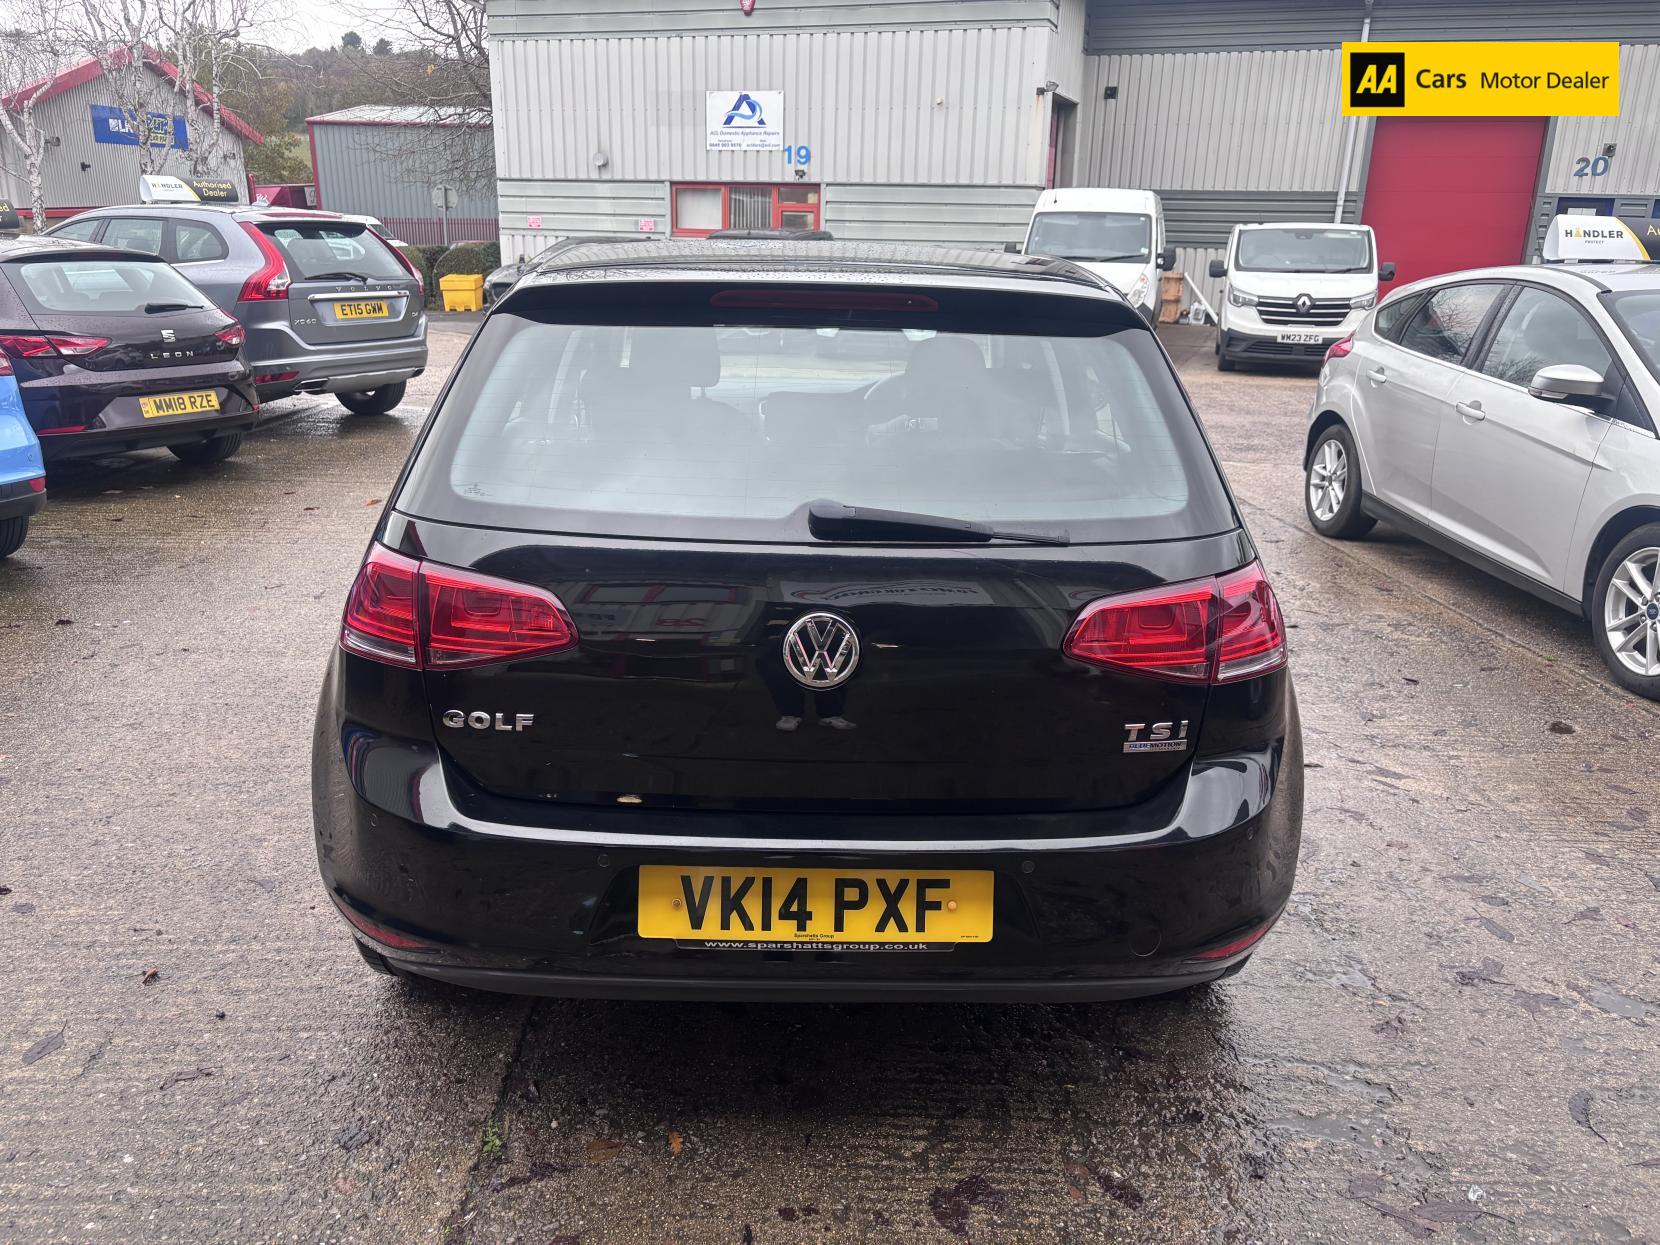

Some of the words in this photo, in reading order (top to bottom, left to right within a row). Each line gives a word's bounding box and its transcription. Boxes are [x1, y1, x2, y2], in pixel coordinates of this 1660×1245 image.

[784, 145, 812, 165] 19
[1573, 156, 1610, 177] 20
[193, 180, 232, 189] Authorised
[202, 188, 227, 197] Dealer
[340, 304, 363, 316] ET15
[294, 317, 317, 325] XC60
[150, 350, 194, 360] LEON
[153, 396, 187, 414] MM18
[188, 394, 215, 411] RZE
[442, 709, 535, 732] GOLF
[680, 875, 813, 932] VK14
[833, 878, 951, 933] PXF
[704, 941, 928, 951] www.sparshattsgroup.co.uk
